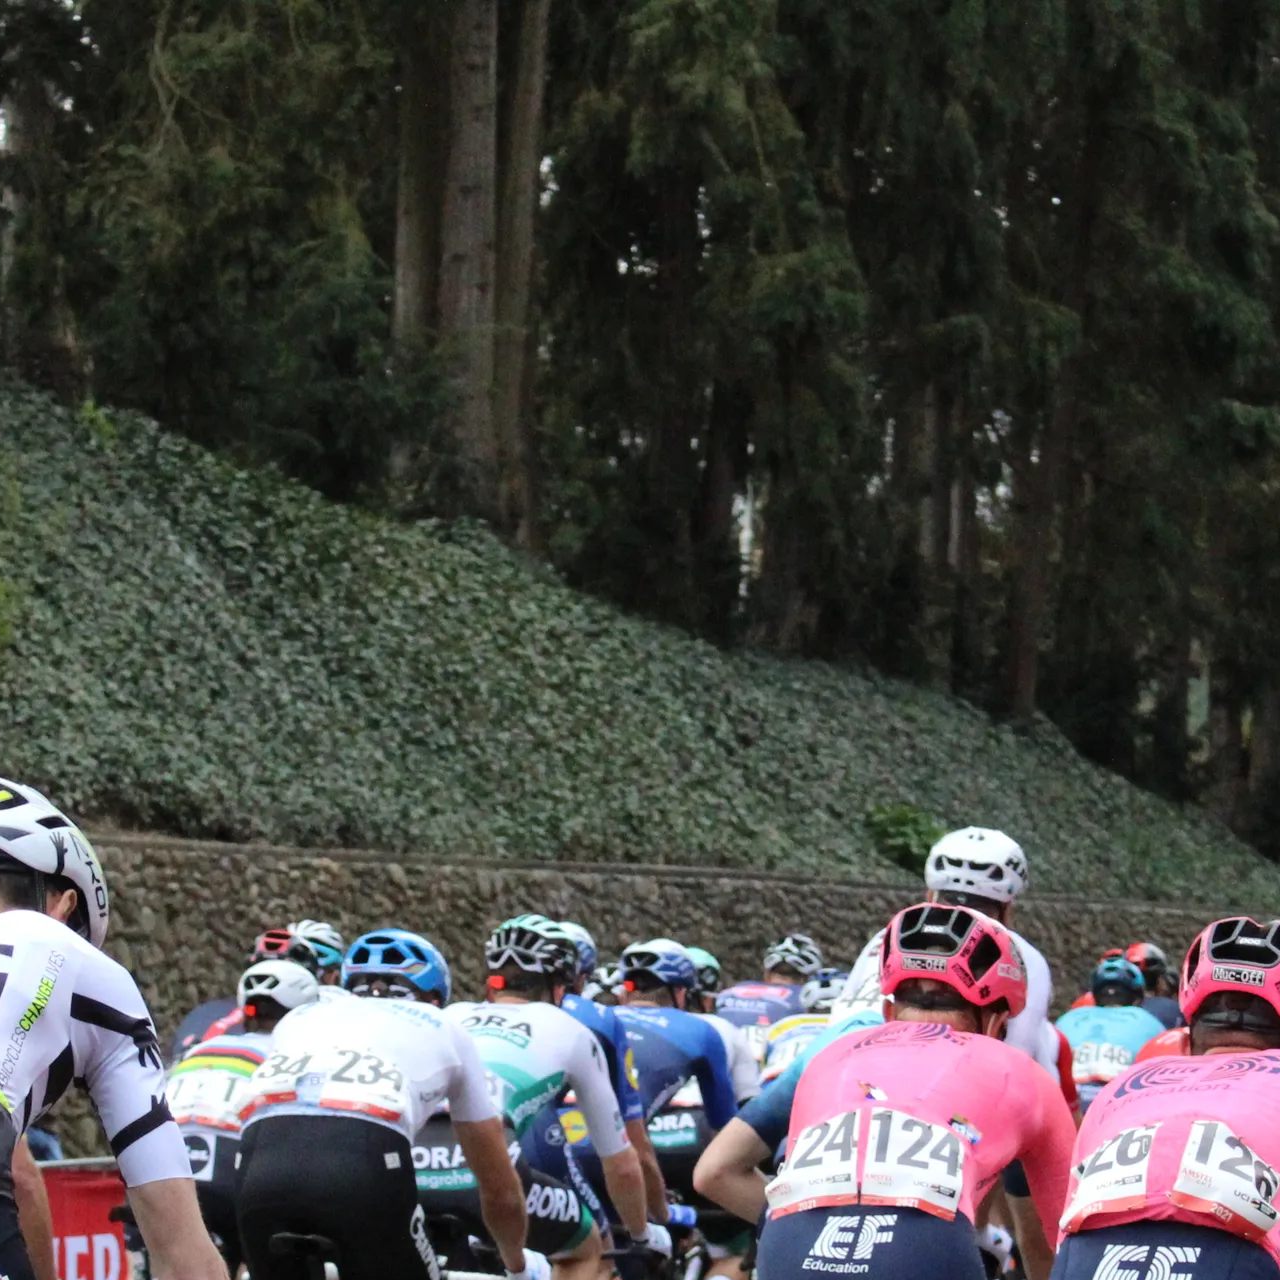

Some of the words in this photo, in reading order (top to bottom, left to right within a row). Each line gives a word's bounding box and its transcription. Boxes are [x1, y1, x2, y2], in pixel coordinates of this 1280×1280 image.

[1215, 966, 1264, 985] Muc-Off
[871, 1109, 964, 1178] 124
[1181, 1167, 1213, 1182] AMSTEL
[525, 1183, 580, 1223] BORA
[1233, 1189, 1251, 1203] UCI
[1210, 1203, 1233, 1221] 2021
[808, 1214, 898, 1260] EF
[801, 1259, 870, 1274] Education
